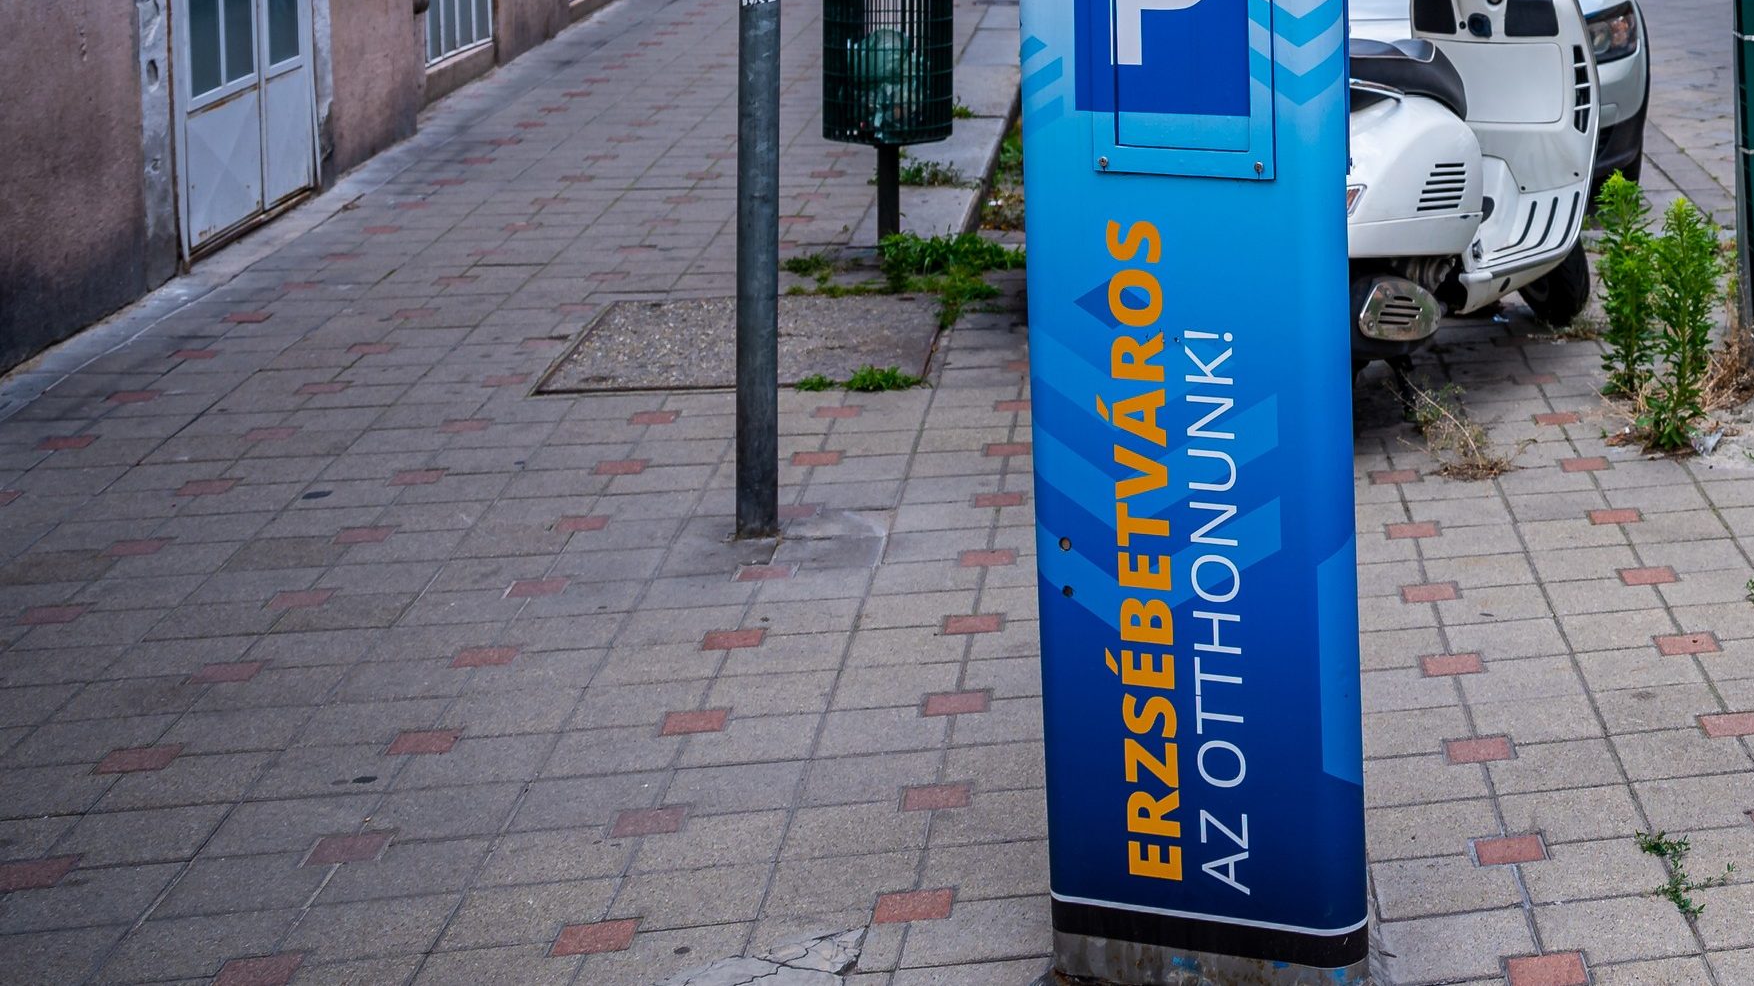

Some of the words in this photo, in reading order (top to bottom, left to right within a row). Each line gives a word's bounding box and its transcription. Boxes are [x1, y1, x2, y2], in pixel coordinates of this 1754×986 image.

[1096, 219, 1183, 881] ERZSÉBETVÁROS
[1184, 328, 1247, 790] OTTHONUNK!
[1201, 813, 1251, 896] AZ
